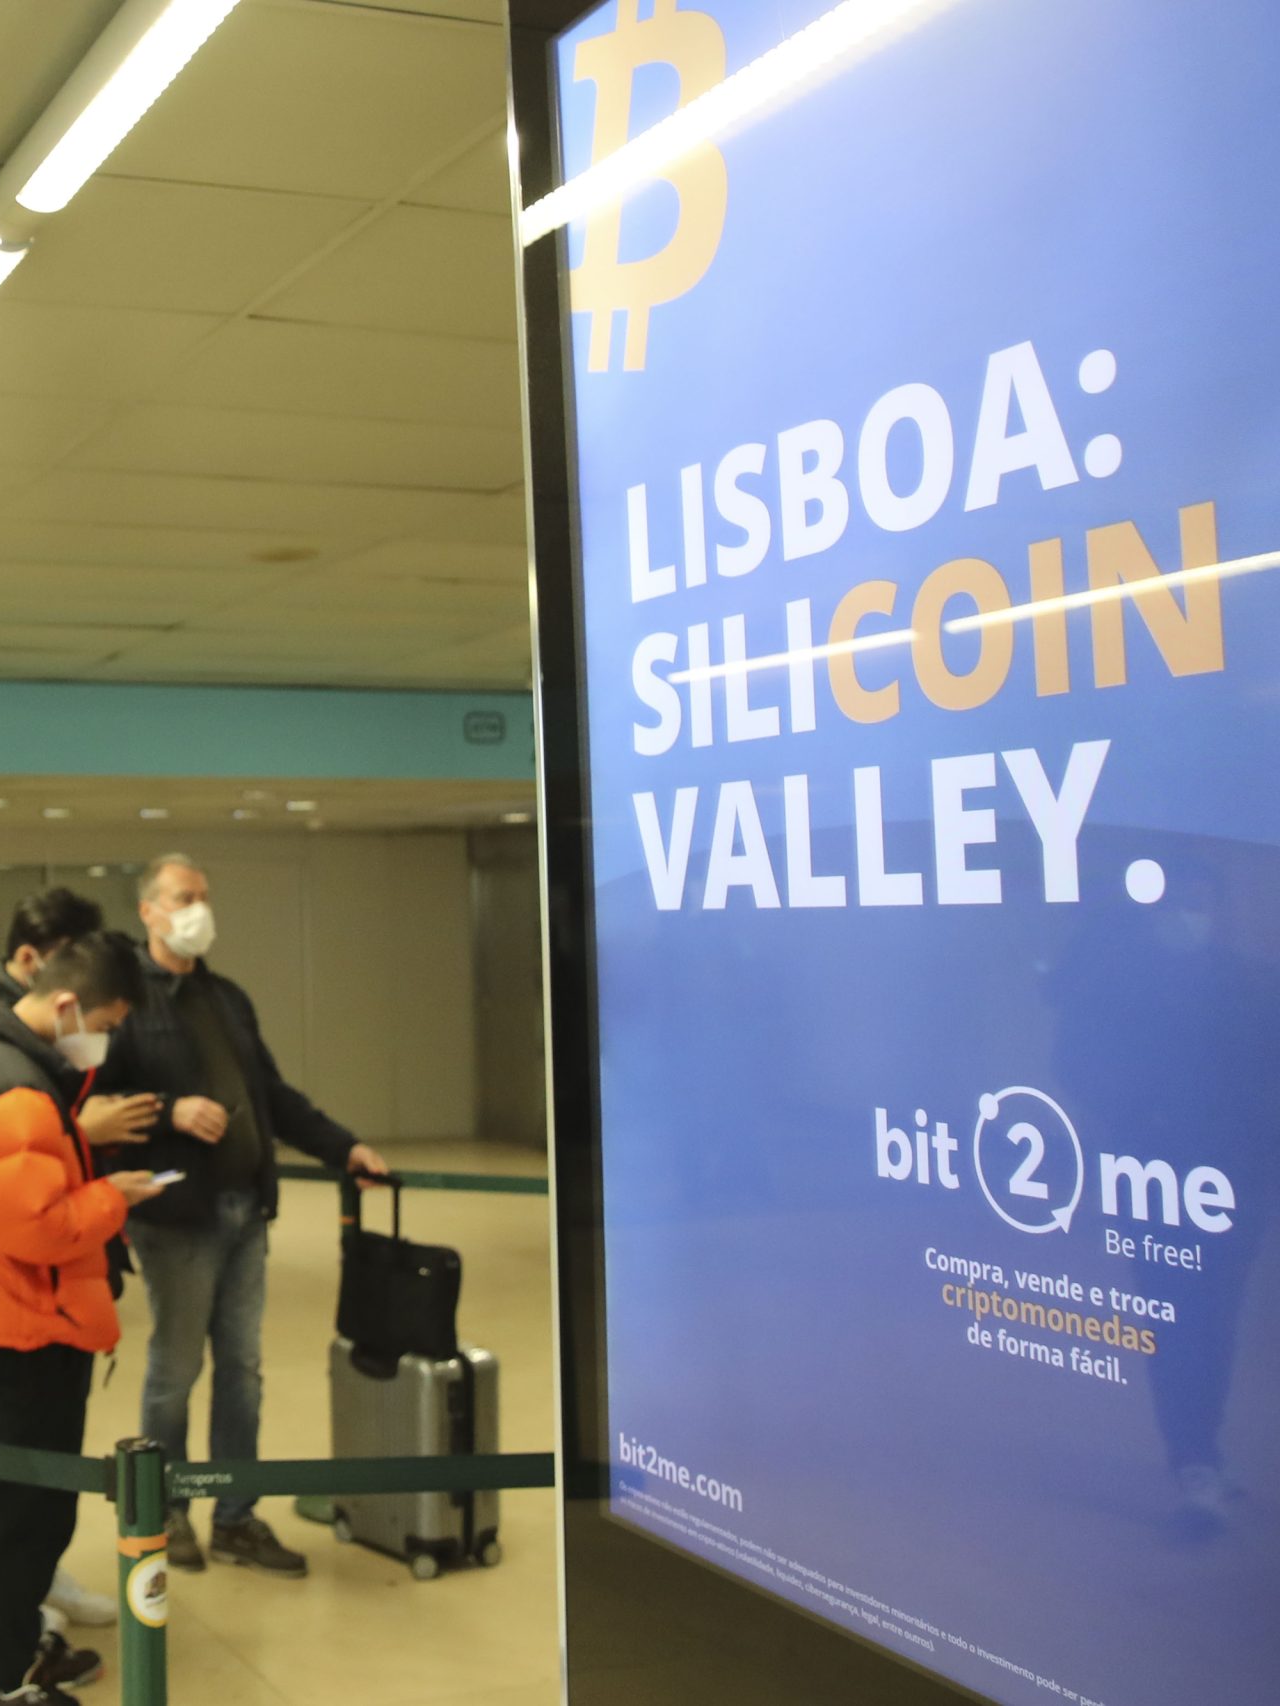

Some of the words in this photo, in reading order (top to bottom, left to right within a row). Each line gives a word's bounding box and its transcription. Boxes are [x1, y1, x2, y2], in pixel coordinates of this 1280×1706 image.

[626, 340, 1122, 604] LISBOA:
[631, 501, 1224, 756] SILICOIN
[632, 739, 1166, 910] VALLEY.
[925, 1247, 1010, 1289] Compra,
[1015, 1270, 1084, 1302] vende
[1089, 1286, 1104, 1306] e
[1109, 1287, 1176, 1323] troca
[1105, 1229, 1135, 1259] Be
[1142, 1235, 1202, 1271] free!
[942, 1282, 1156, 1355] criptomonedas
[967, 1322, 993, 1348] de
[997, 1329, 1064, 1367] forma
[1070, 1347, 1128, 1385] fácil.
[619, 1432, 743, 1512] bit2me.com
[948, 1632, 968, 1650] todo
[977, 1645, 1035, 1680] investimento
[1036, 1674, 1061, 1692] pode
